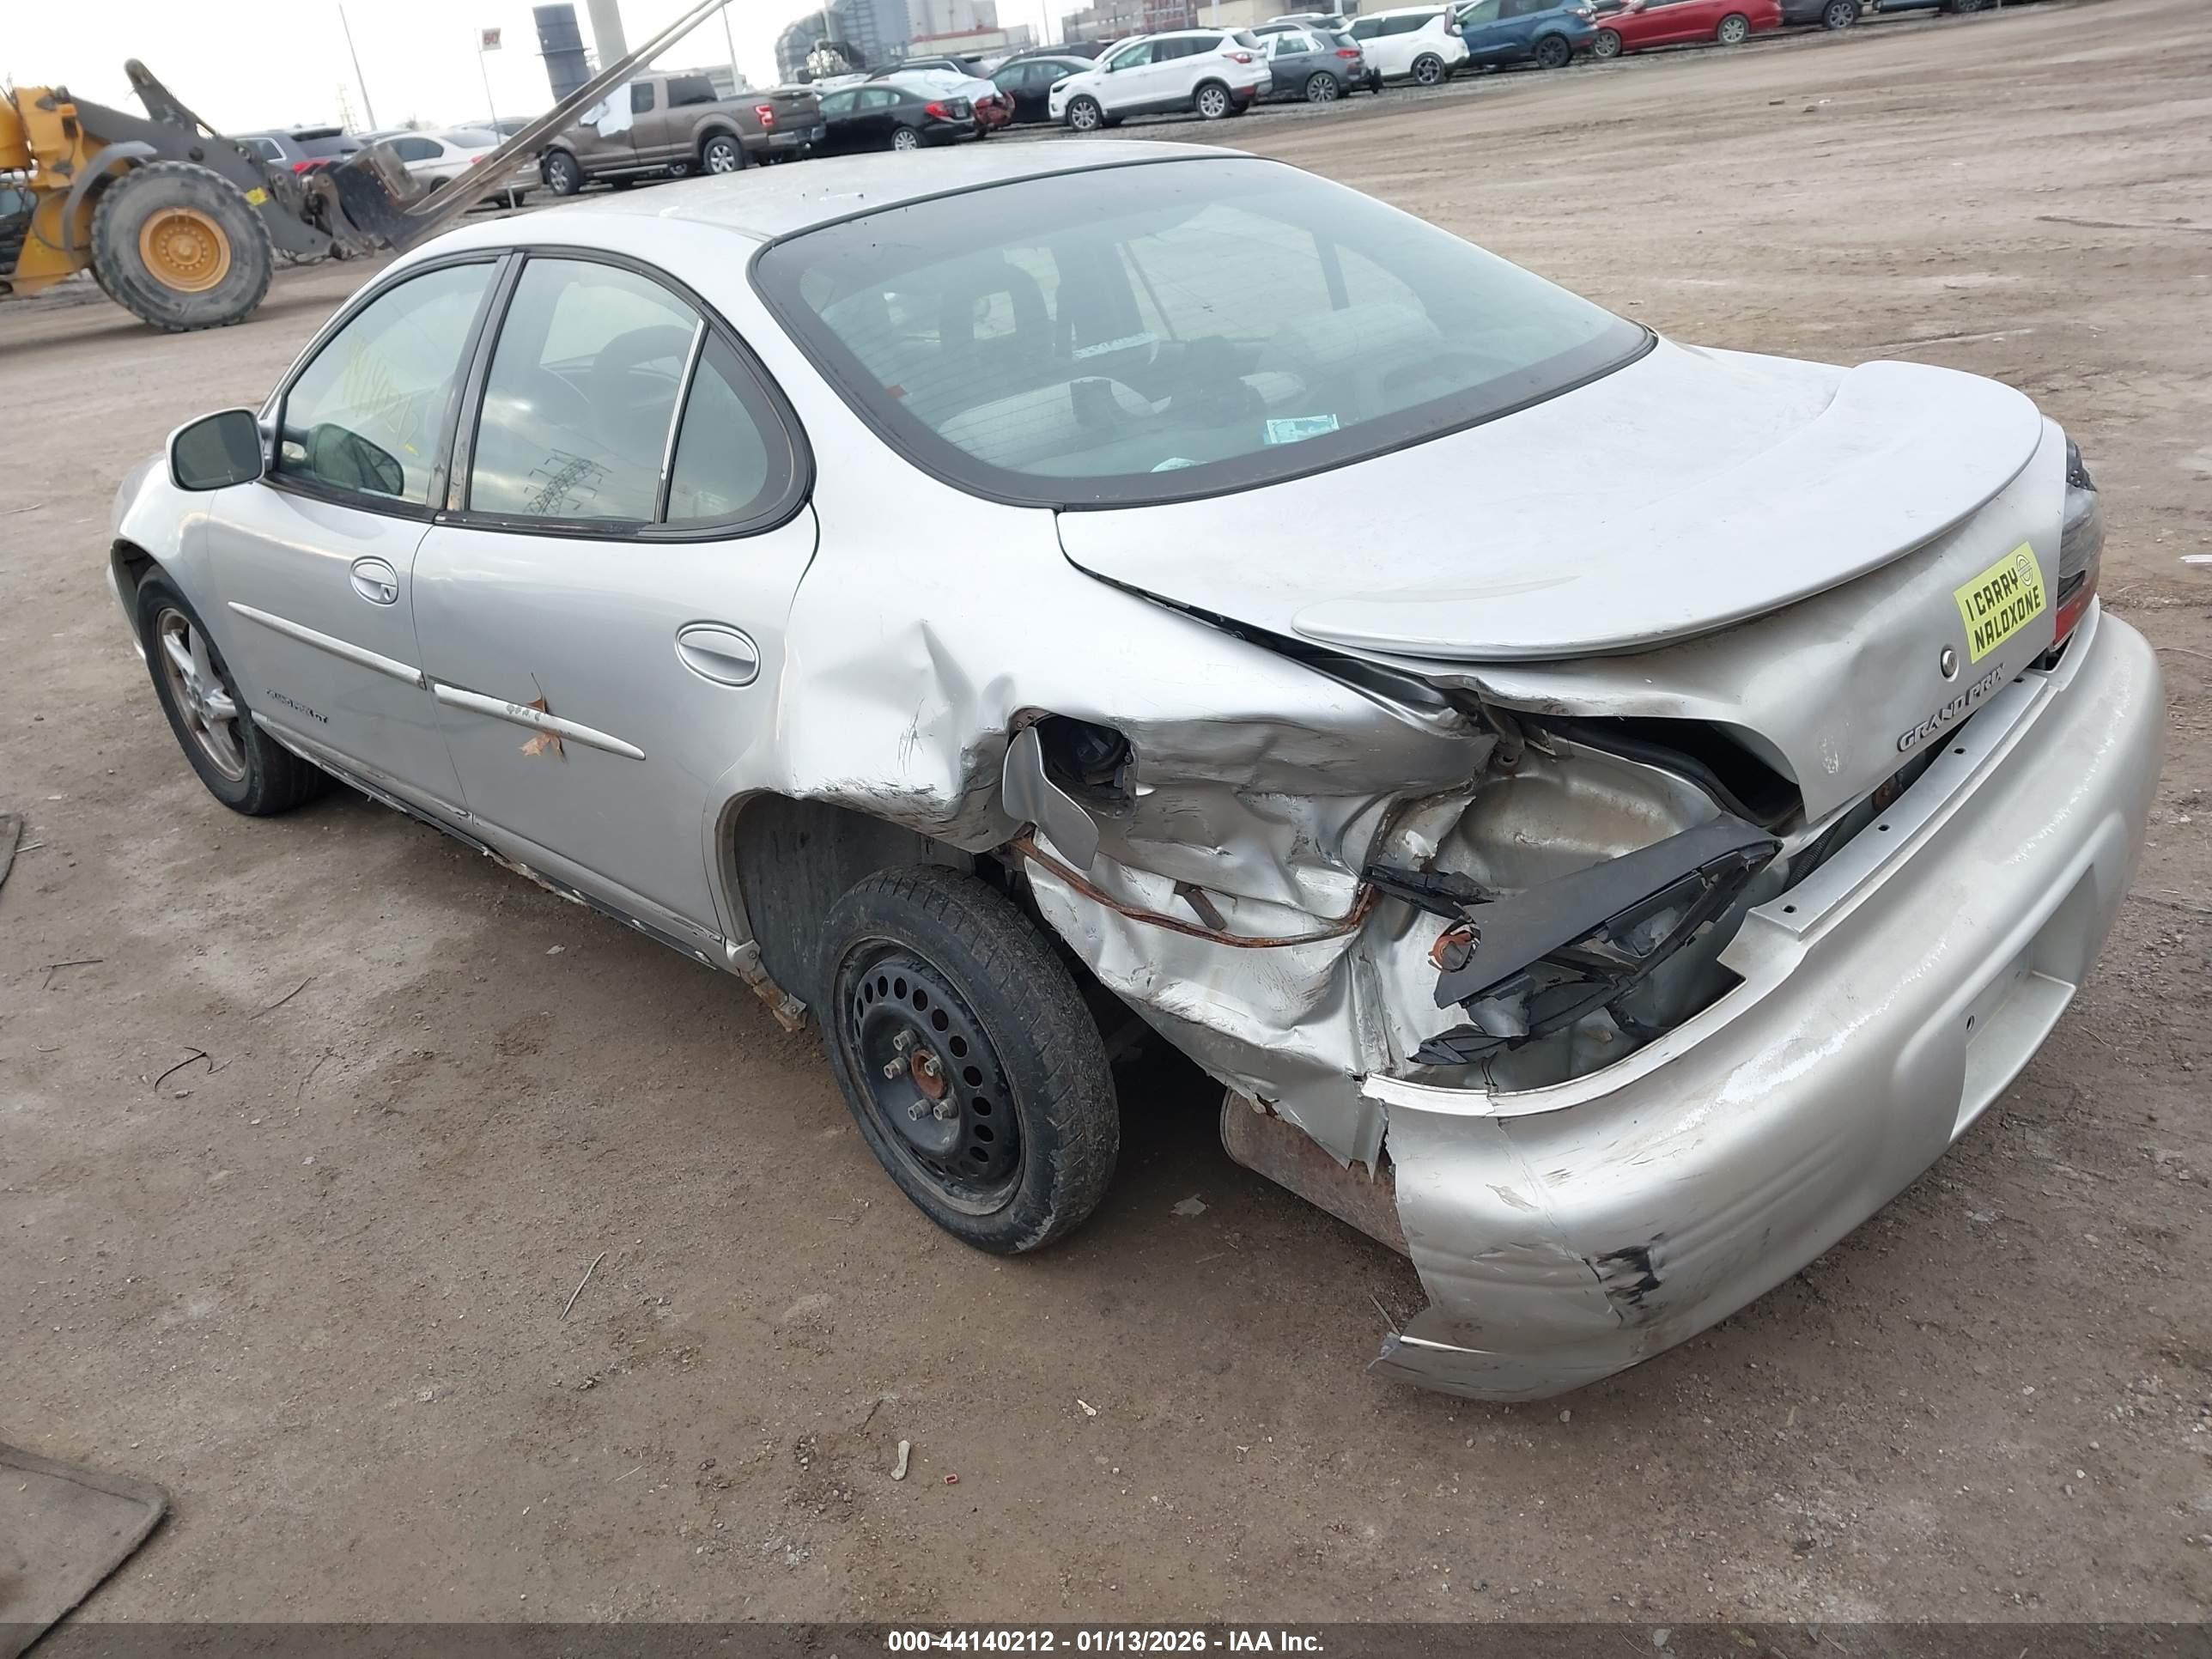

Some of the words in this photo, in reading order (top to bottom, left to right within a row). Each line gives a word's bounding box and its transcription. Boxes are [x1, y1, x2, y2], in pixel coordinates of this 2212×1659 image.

[1965, 599, 1975, 623] I
[1973, 568, 2019, 617] CARRY
[1974, 585, 2041, 653] NALOXONE
[1897, 695, 1966, 752] GRAND
[1965, 662, 2005, 706] PRIX
